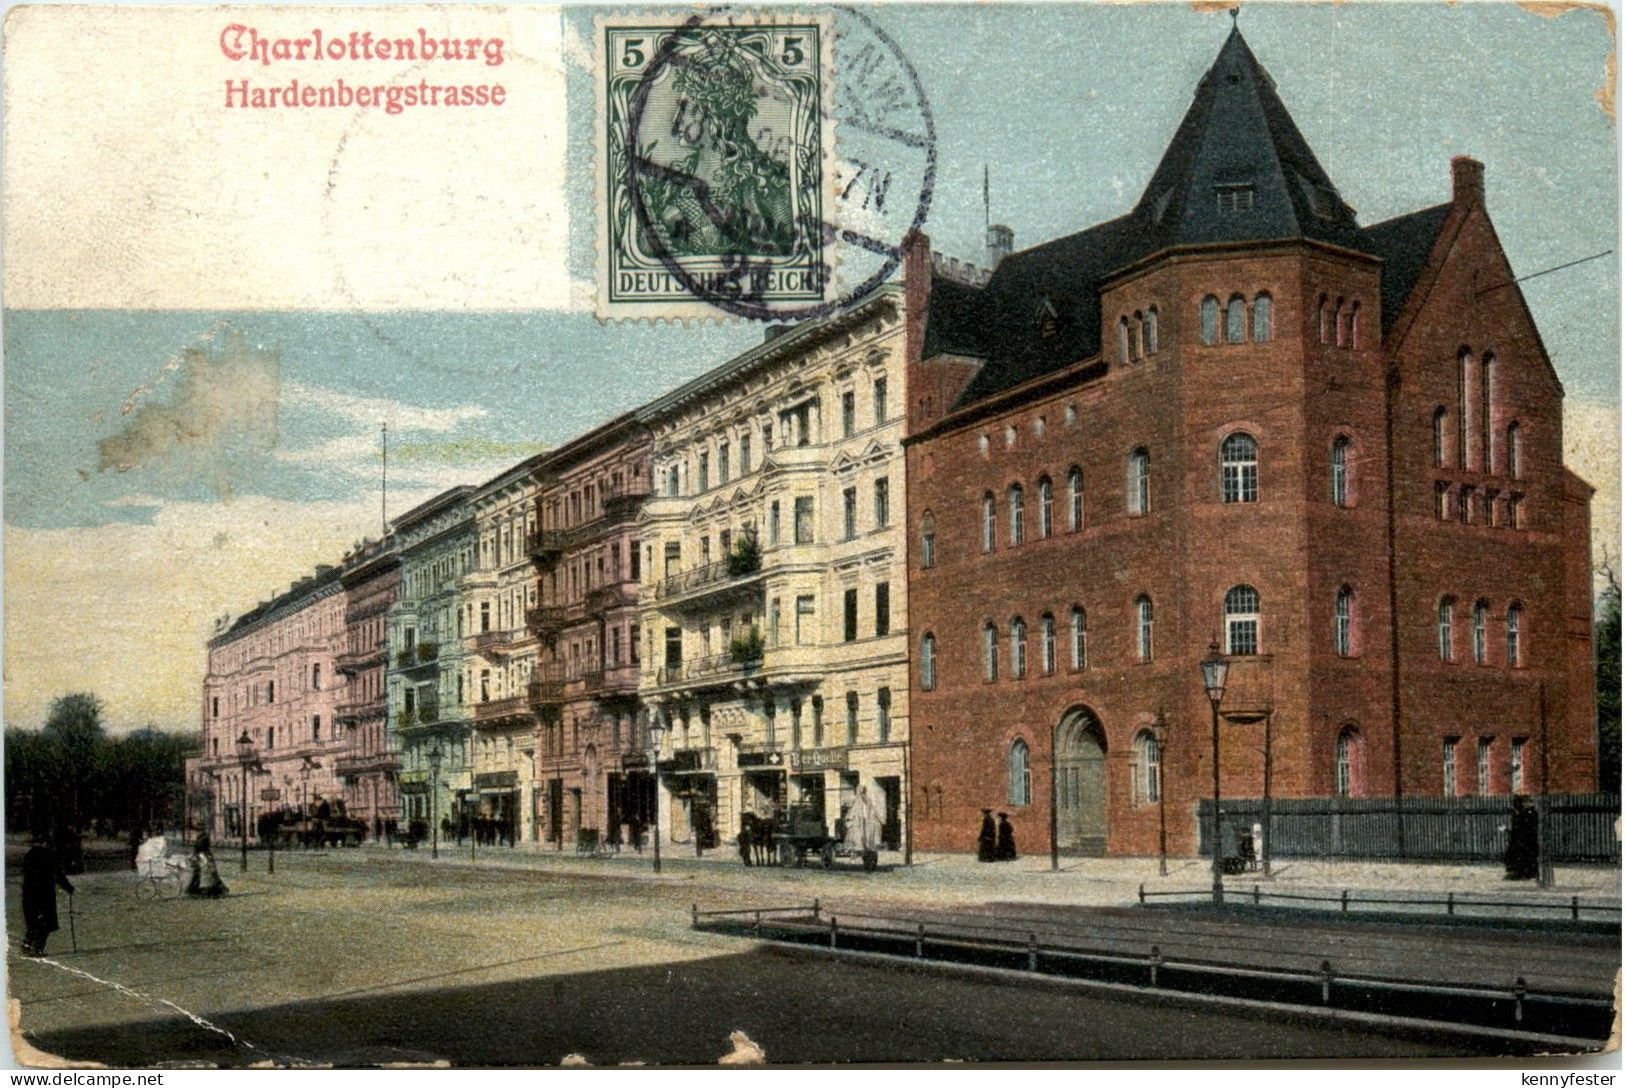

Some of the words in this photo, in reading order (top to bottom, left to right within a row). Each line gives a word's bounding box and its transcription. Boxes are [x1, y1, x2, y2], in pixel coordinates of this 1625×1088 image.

[220, 24, 505, 66] Charlottenburg
[622, 39, 645, 67] 5
[782, 37, 804, 66] 5
[225, 79, 507, 115] Hardenbergstrasse
